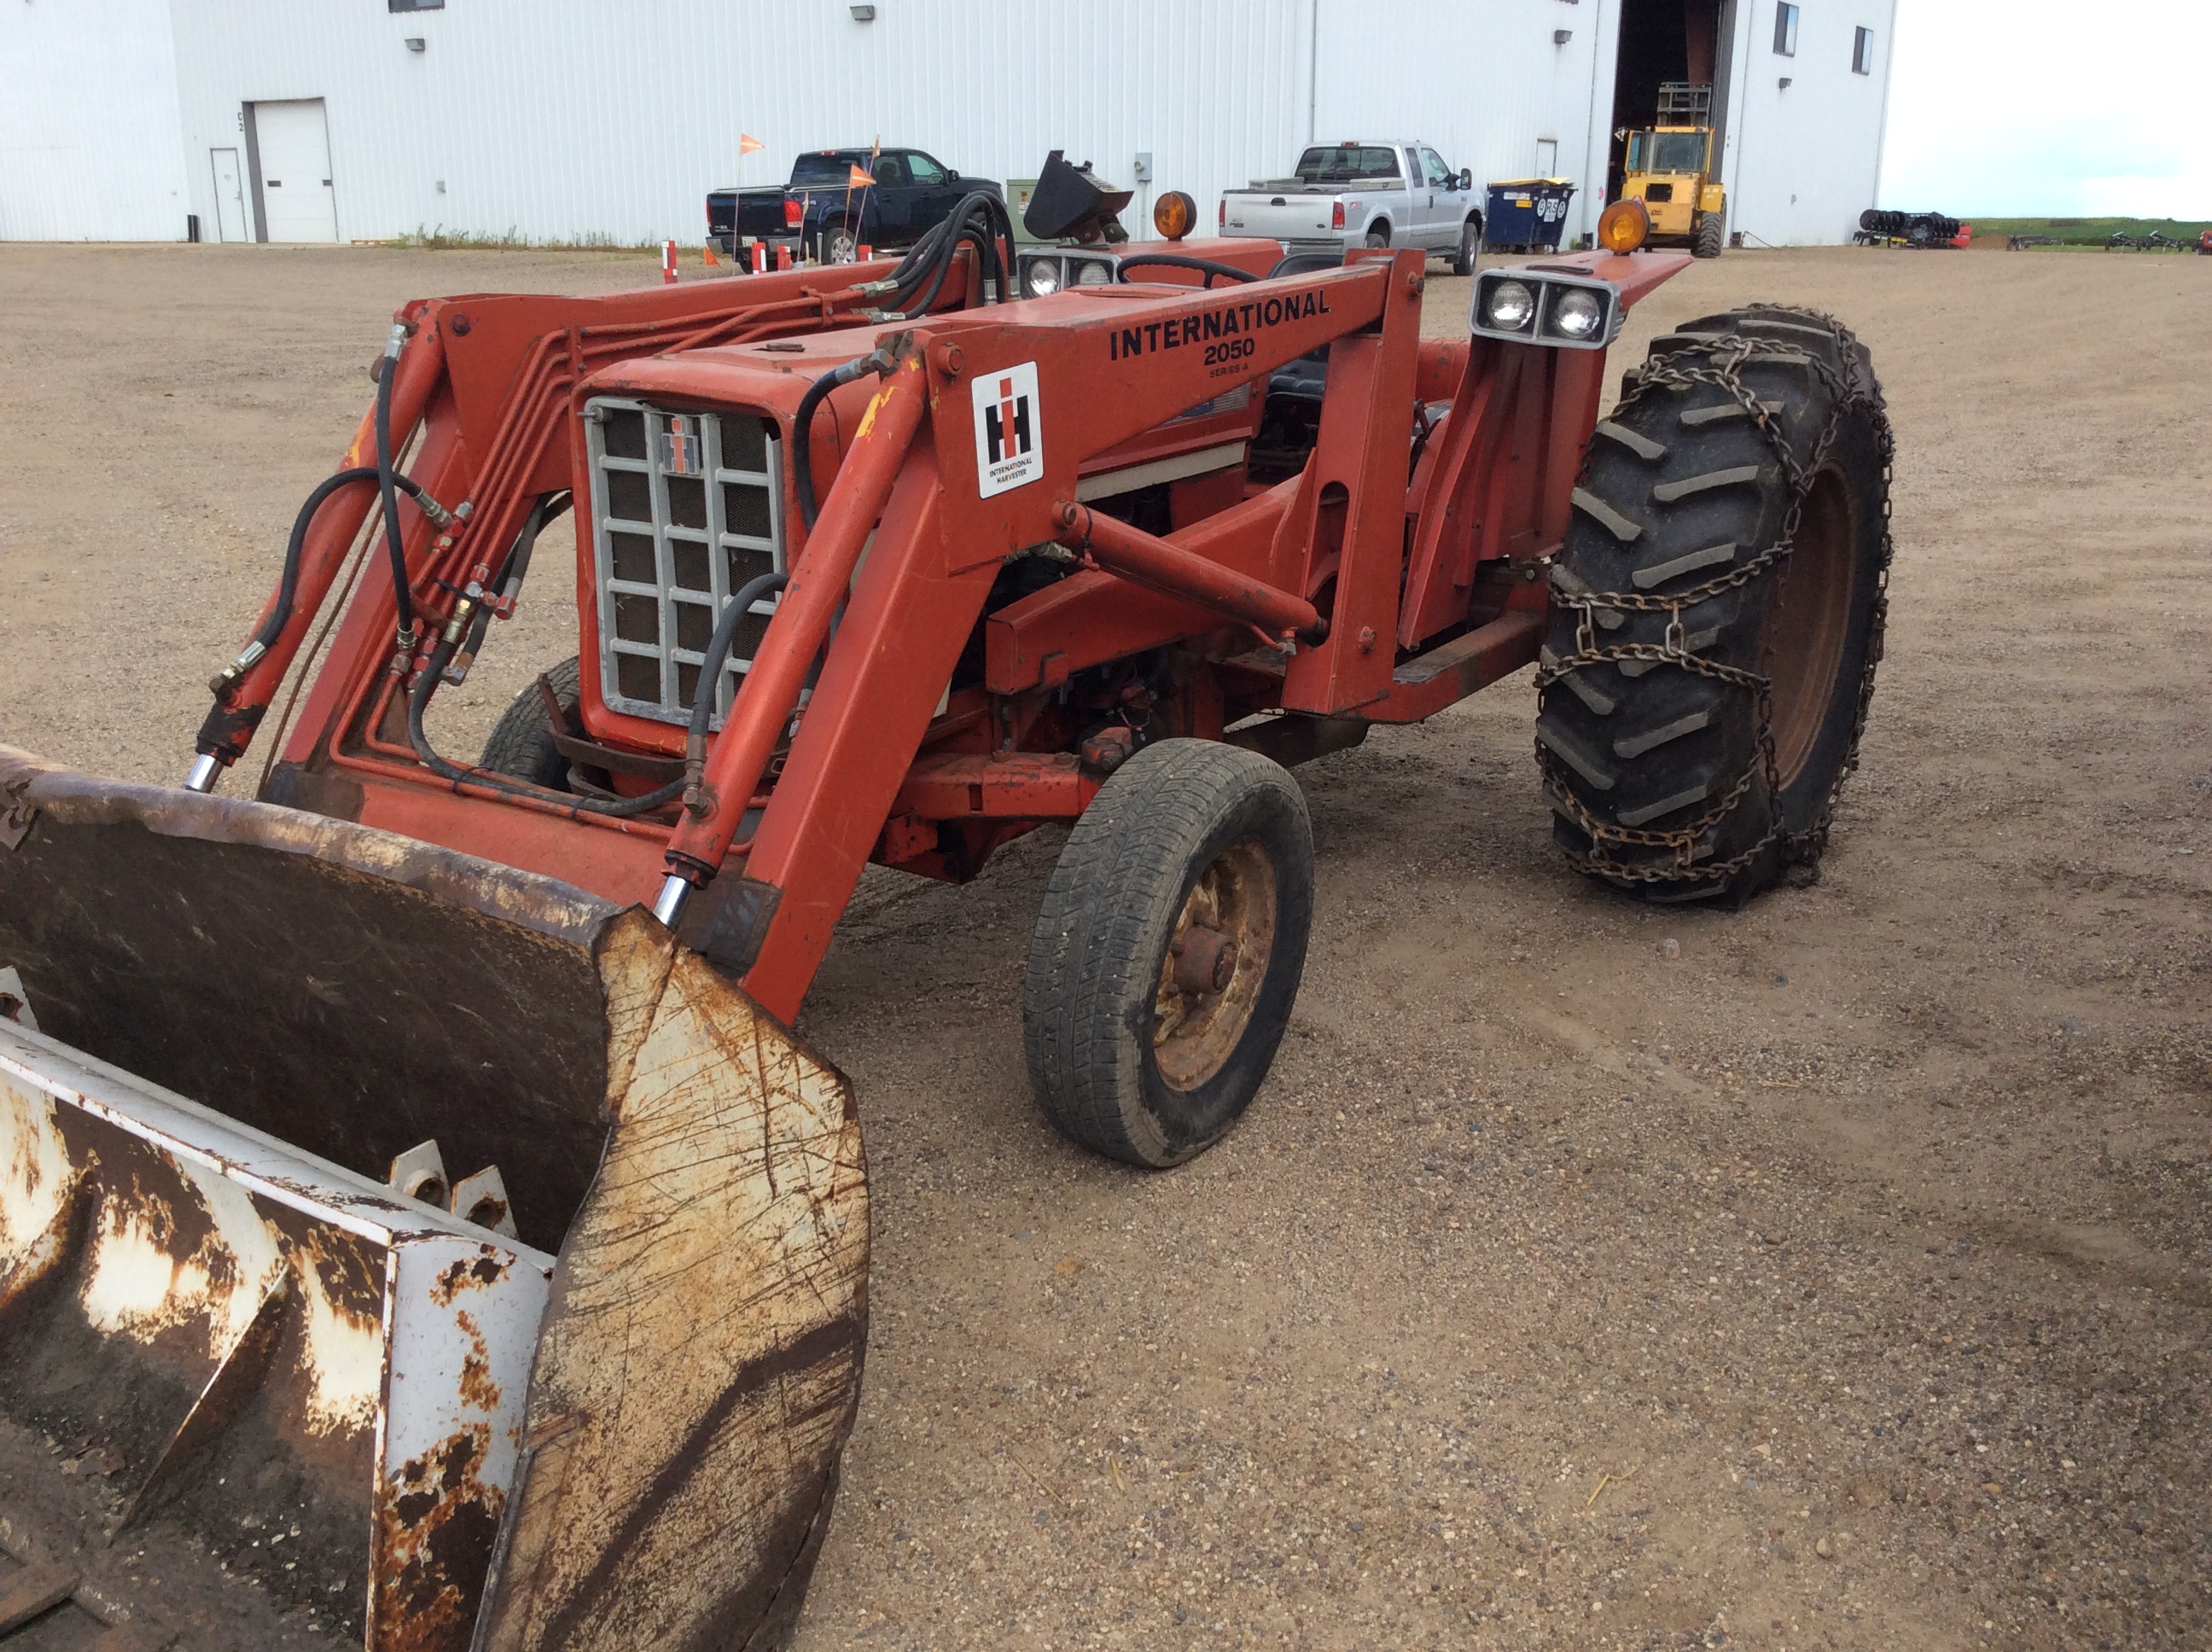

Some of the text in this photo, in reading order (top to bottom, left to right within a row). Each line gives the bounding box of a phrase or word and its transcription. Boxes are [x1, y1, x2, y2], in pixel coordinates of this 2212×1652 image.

[1110, 289, 1331, 361] INTERNATIONAL
[1204, 337, 1255, 366] 2050
[1210, 363, 1249, 378] SERIES A
[990, 457, 1033, 478] INTERNATIONAL
[997, 468, 1027, 484] HARVESTER
